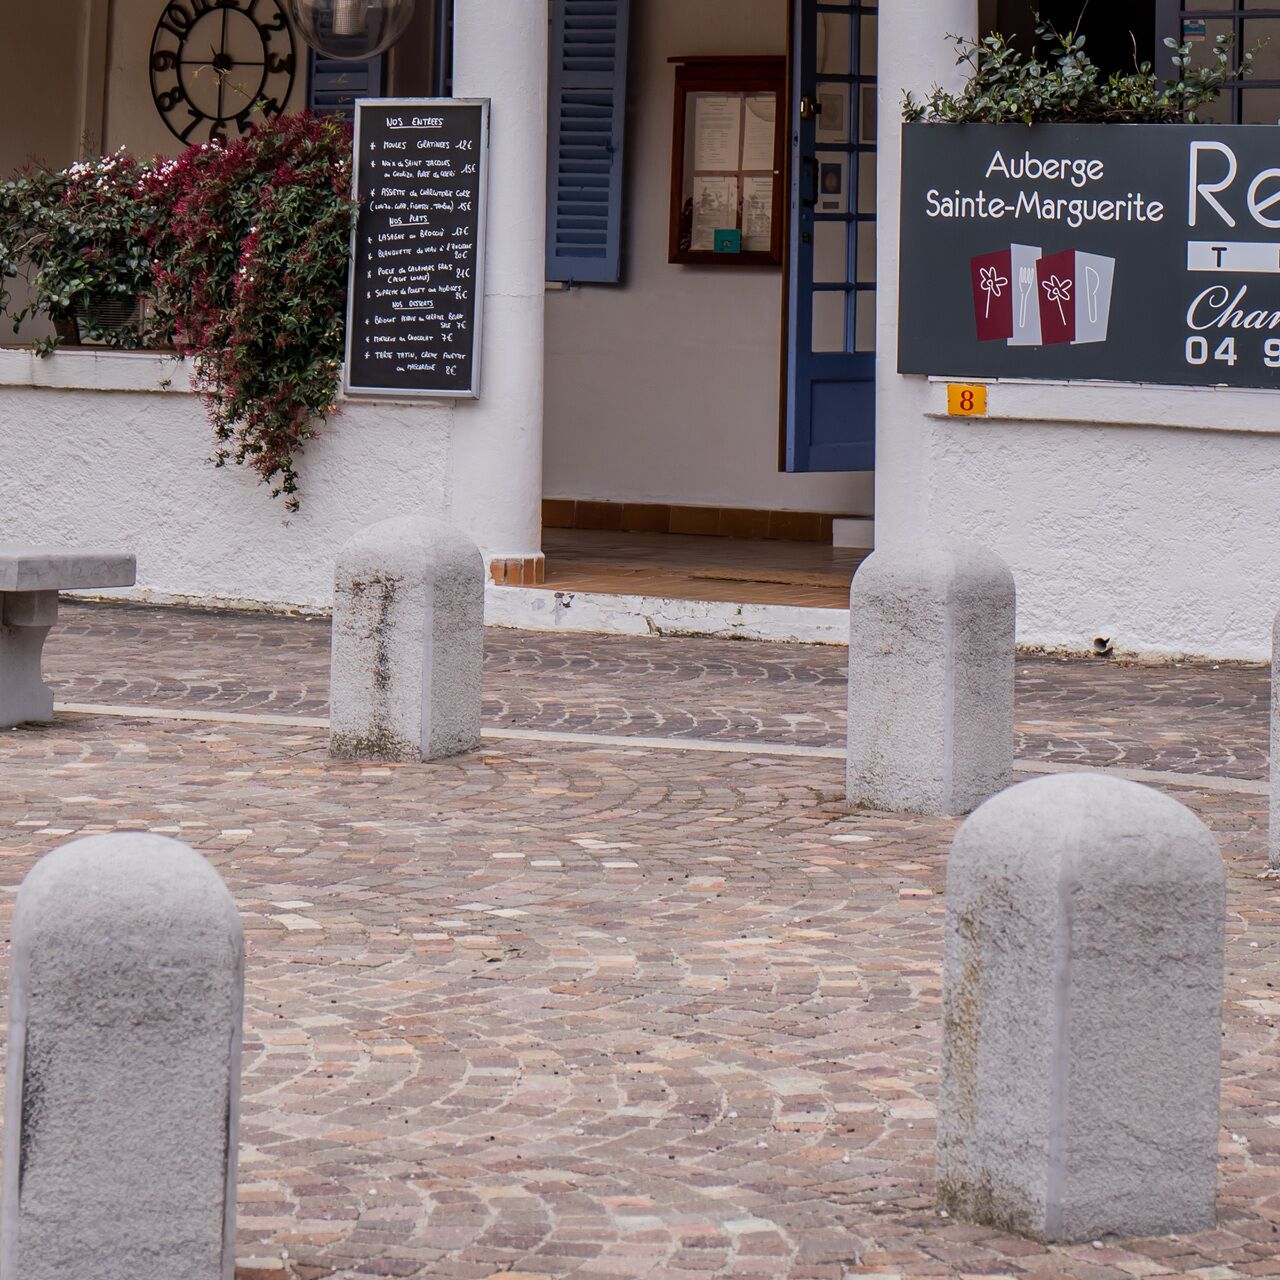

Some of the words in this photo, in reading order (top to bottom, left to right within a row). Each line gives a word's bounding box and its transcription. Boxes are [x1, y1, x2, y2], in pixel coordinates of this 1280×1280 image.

[386, 118, 403, 126] NOS
[384, 141, 406, 149] MOULES
[455, 140, 472, 150] 12€
[405, 159, 422, 167] SAINT
[461, 164, 476, 174] 15€
[986, 151, 1103, 187] Auberge
[381, 188, 406, 197] ASSIETTE
[458, 202, 472, 211] 15€
[926, 189, 1163, 227] Sainte-Marguerite
[389, 217, 402, 225] NOS
[409, 215, 428, 223] PLATS
[378, 233, 405, 242] LASAGNE
[452, 227, 469, 235] 17€
[454, 251, 467, 259] 20€
[457, 321, 466, 329] 7€
[441, 333, 453, 342] 7€
[375, 351, 393, 359] TARTE
[1186, 336, 1237, 365] 04
[445, 365, 457, 375] 8€
[960, 390, 974, 410] 8
